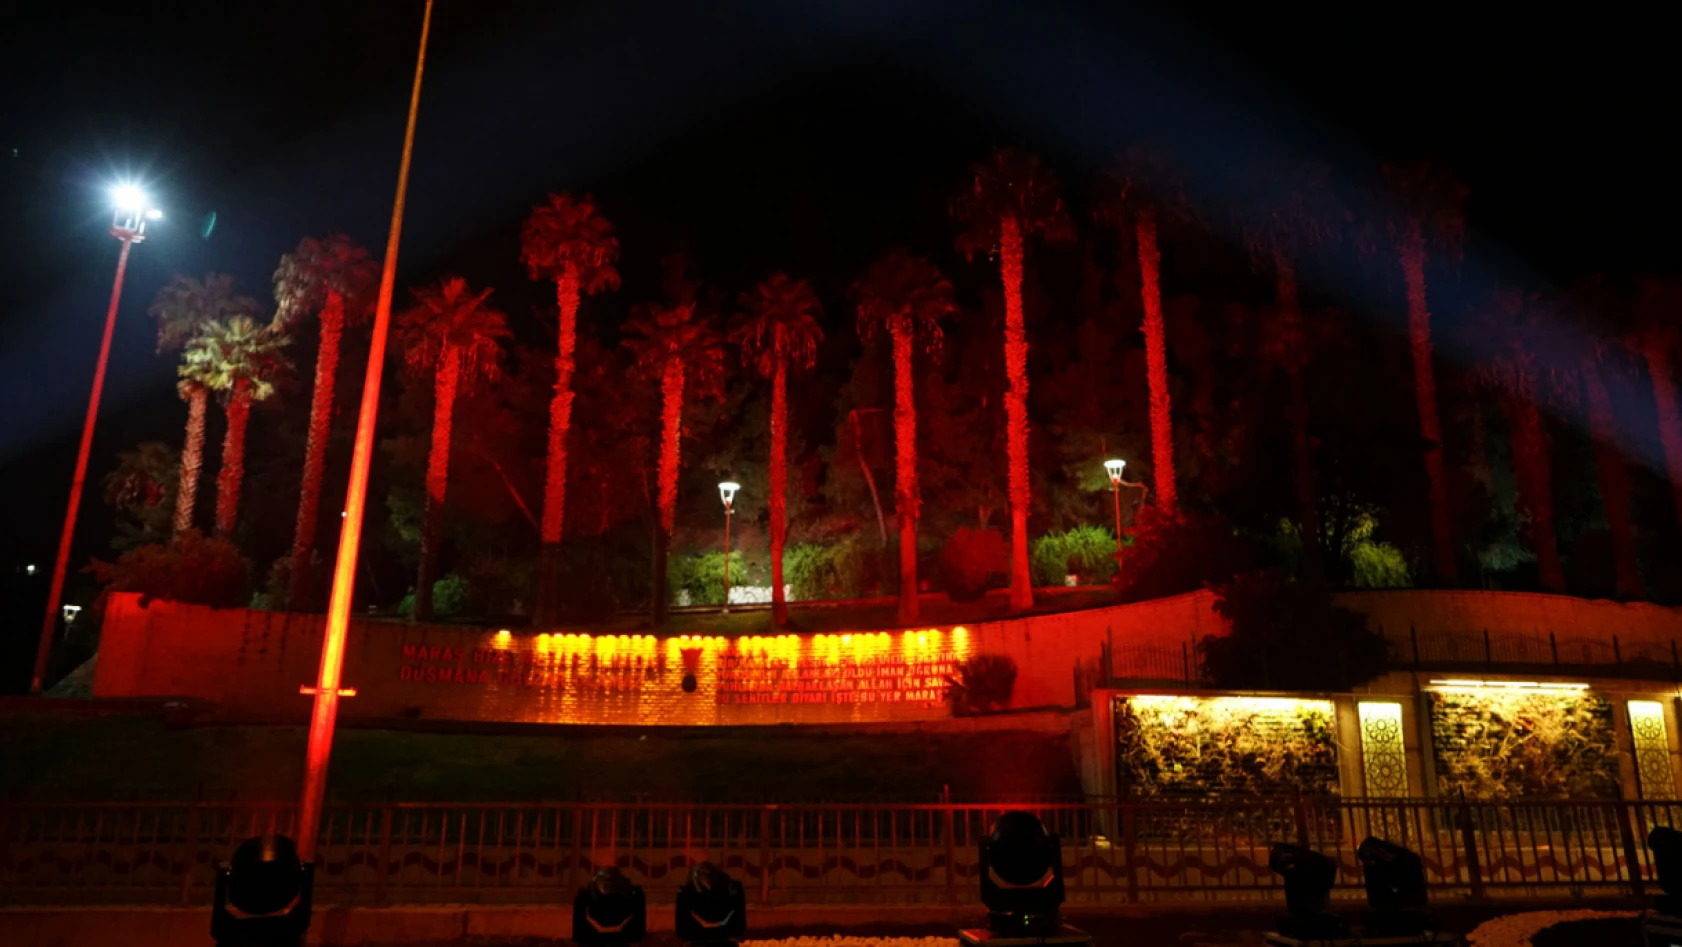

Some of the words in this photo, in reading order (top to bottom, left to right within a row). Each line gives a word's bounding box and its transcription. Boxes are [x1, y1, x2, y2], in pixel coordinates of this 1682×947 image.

[857, 678, 893, 690] ALLAH
[860, 691, 876, 702] BU
[880, 690, 901, 702] YER
